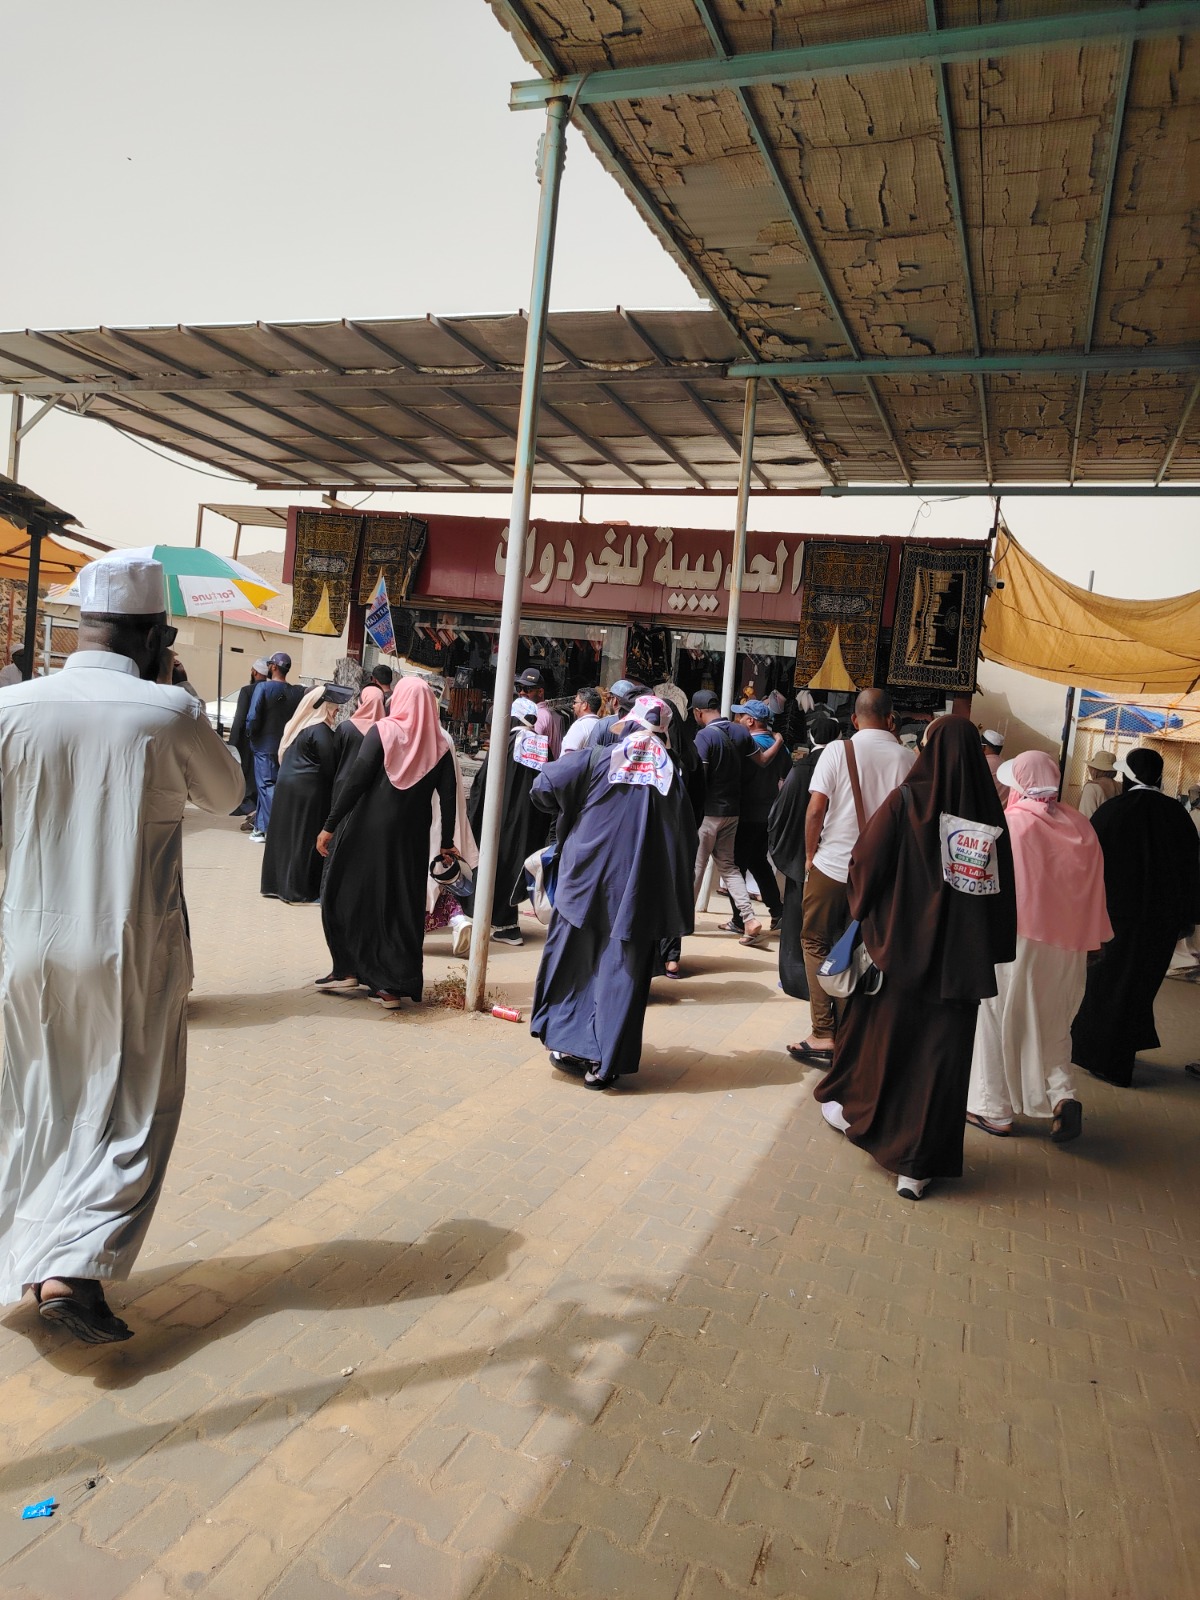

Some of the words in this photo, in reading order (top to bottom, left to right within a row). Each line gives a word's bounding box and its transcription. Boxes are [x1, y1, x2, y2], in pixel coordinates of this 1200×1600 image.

[957, 834, 979, 850] ZAM
[956, 847, 973, 856] HAJJ
[953, 864, 967, 873] SRI
